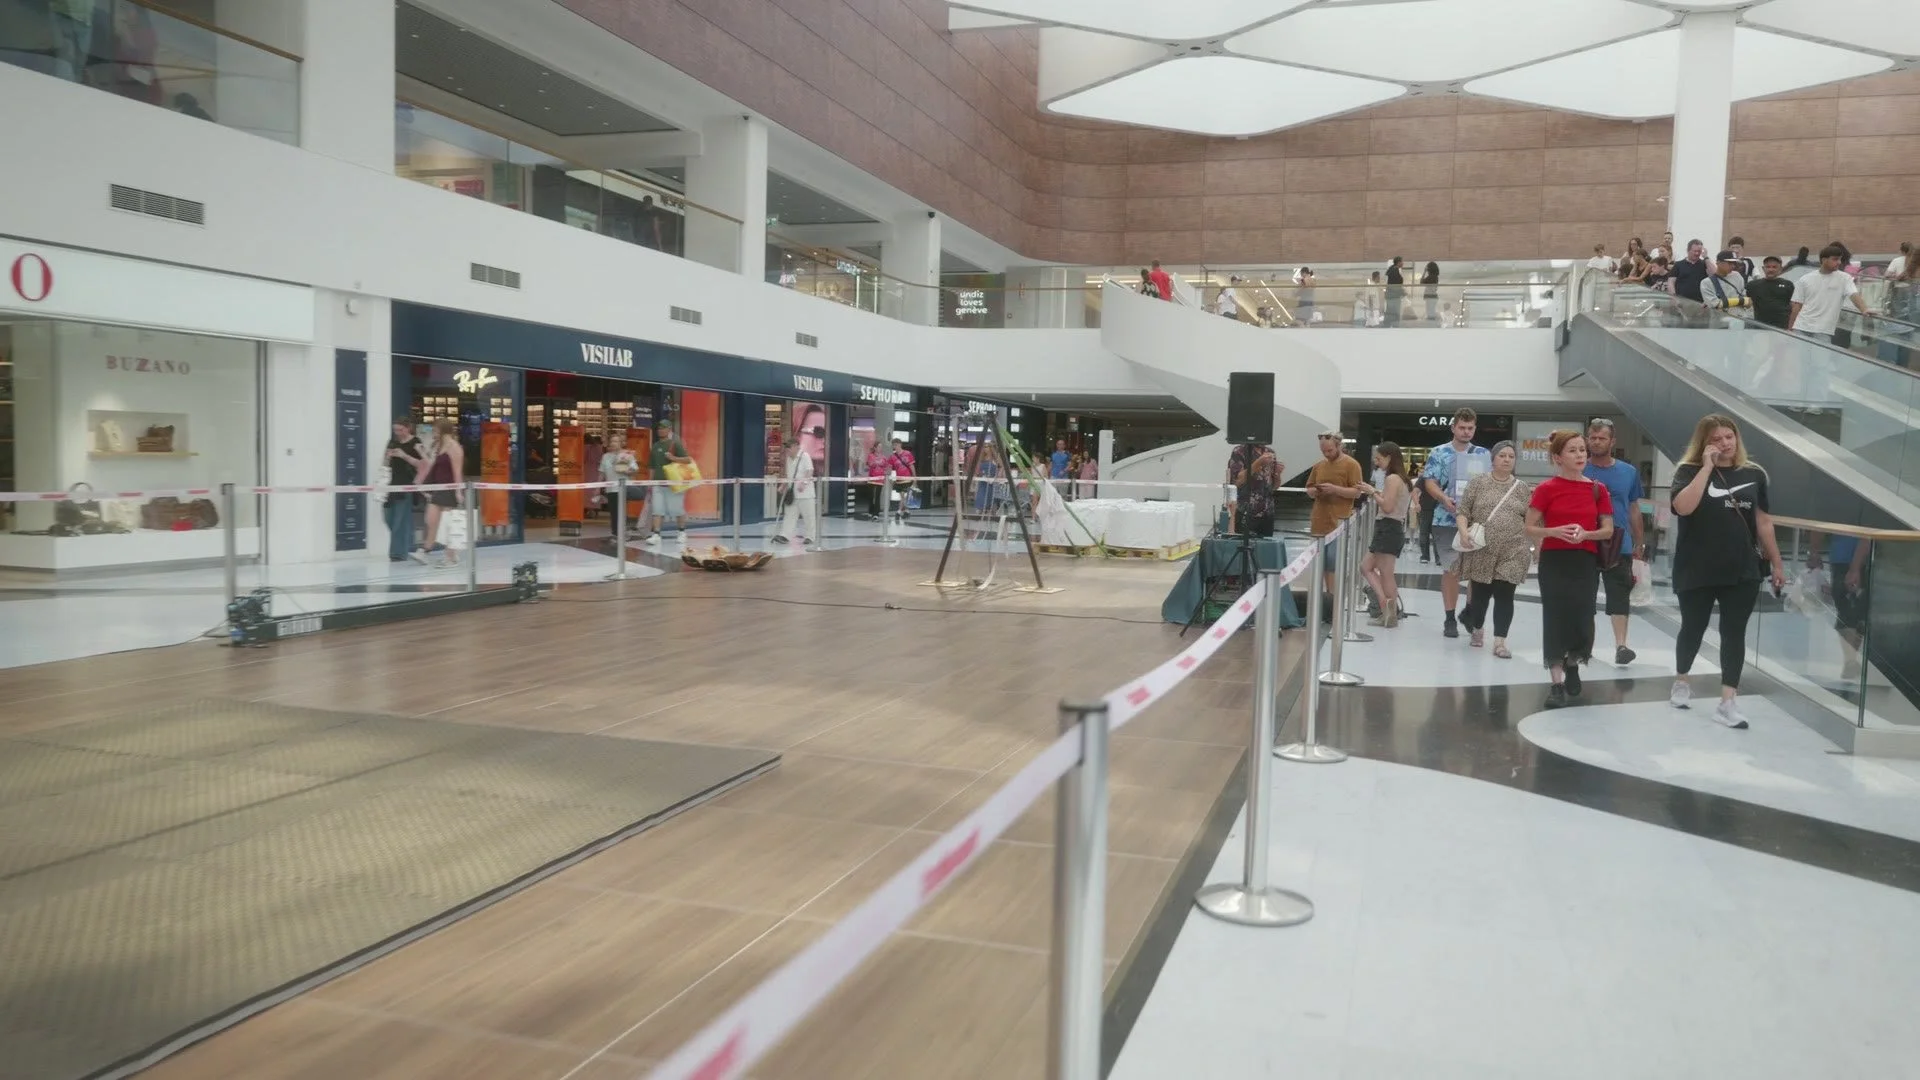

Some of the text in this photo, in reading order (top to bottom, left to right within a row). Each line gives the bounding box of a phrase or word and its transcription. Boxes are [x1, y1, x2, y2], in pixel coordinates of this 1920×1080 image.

[11, 253, 53, 301] O
[959, 289, 984, 298] undiz
[960, 298, 983, 306] loves
[955, 306, 988, 316] genève
[580, 343, 633, 368] VISILAB
[793, 375, 823, 392] VISILAB
[860, 385, 903, 404] SEPHORA
[1724, 499, 1752, 509] Runing
